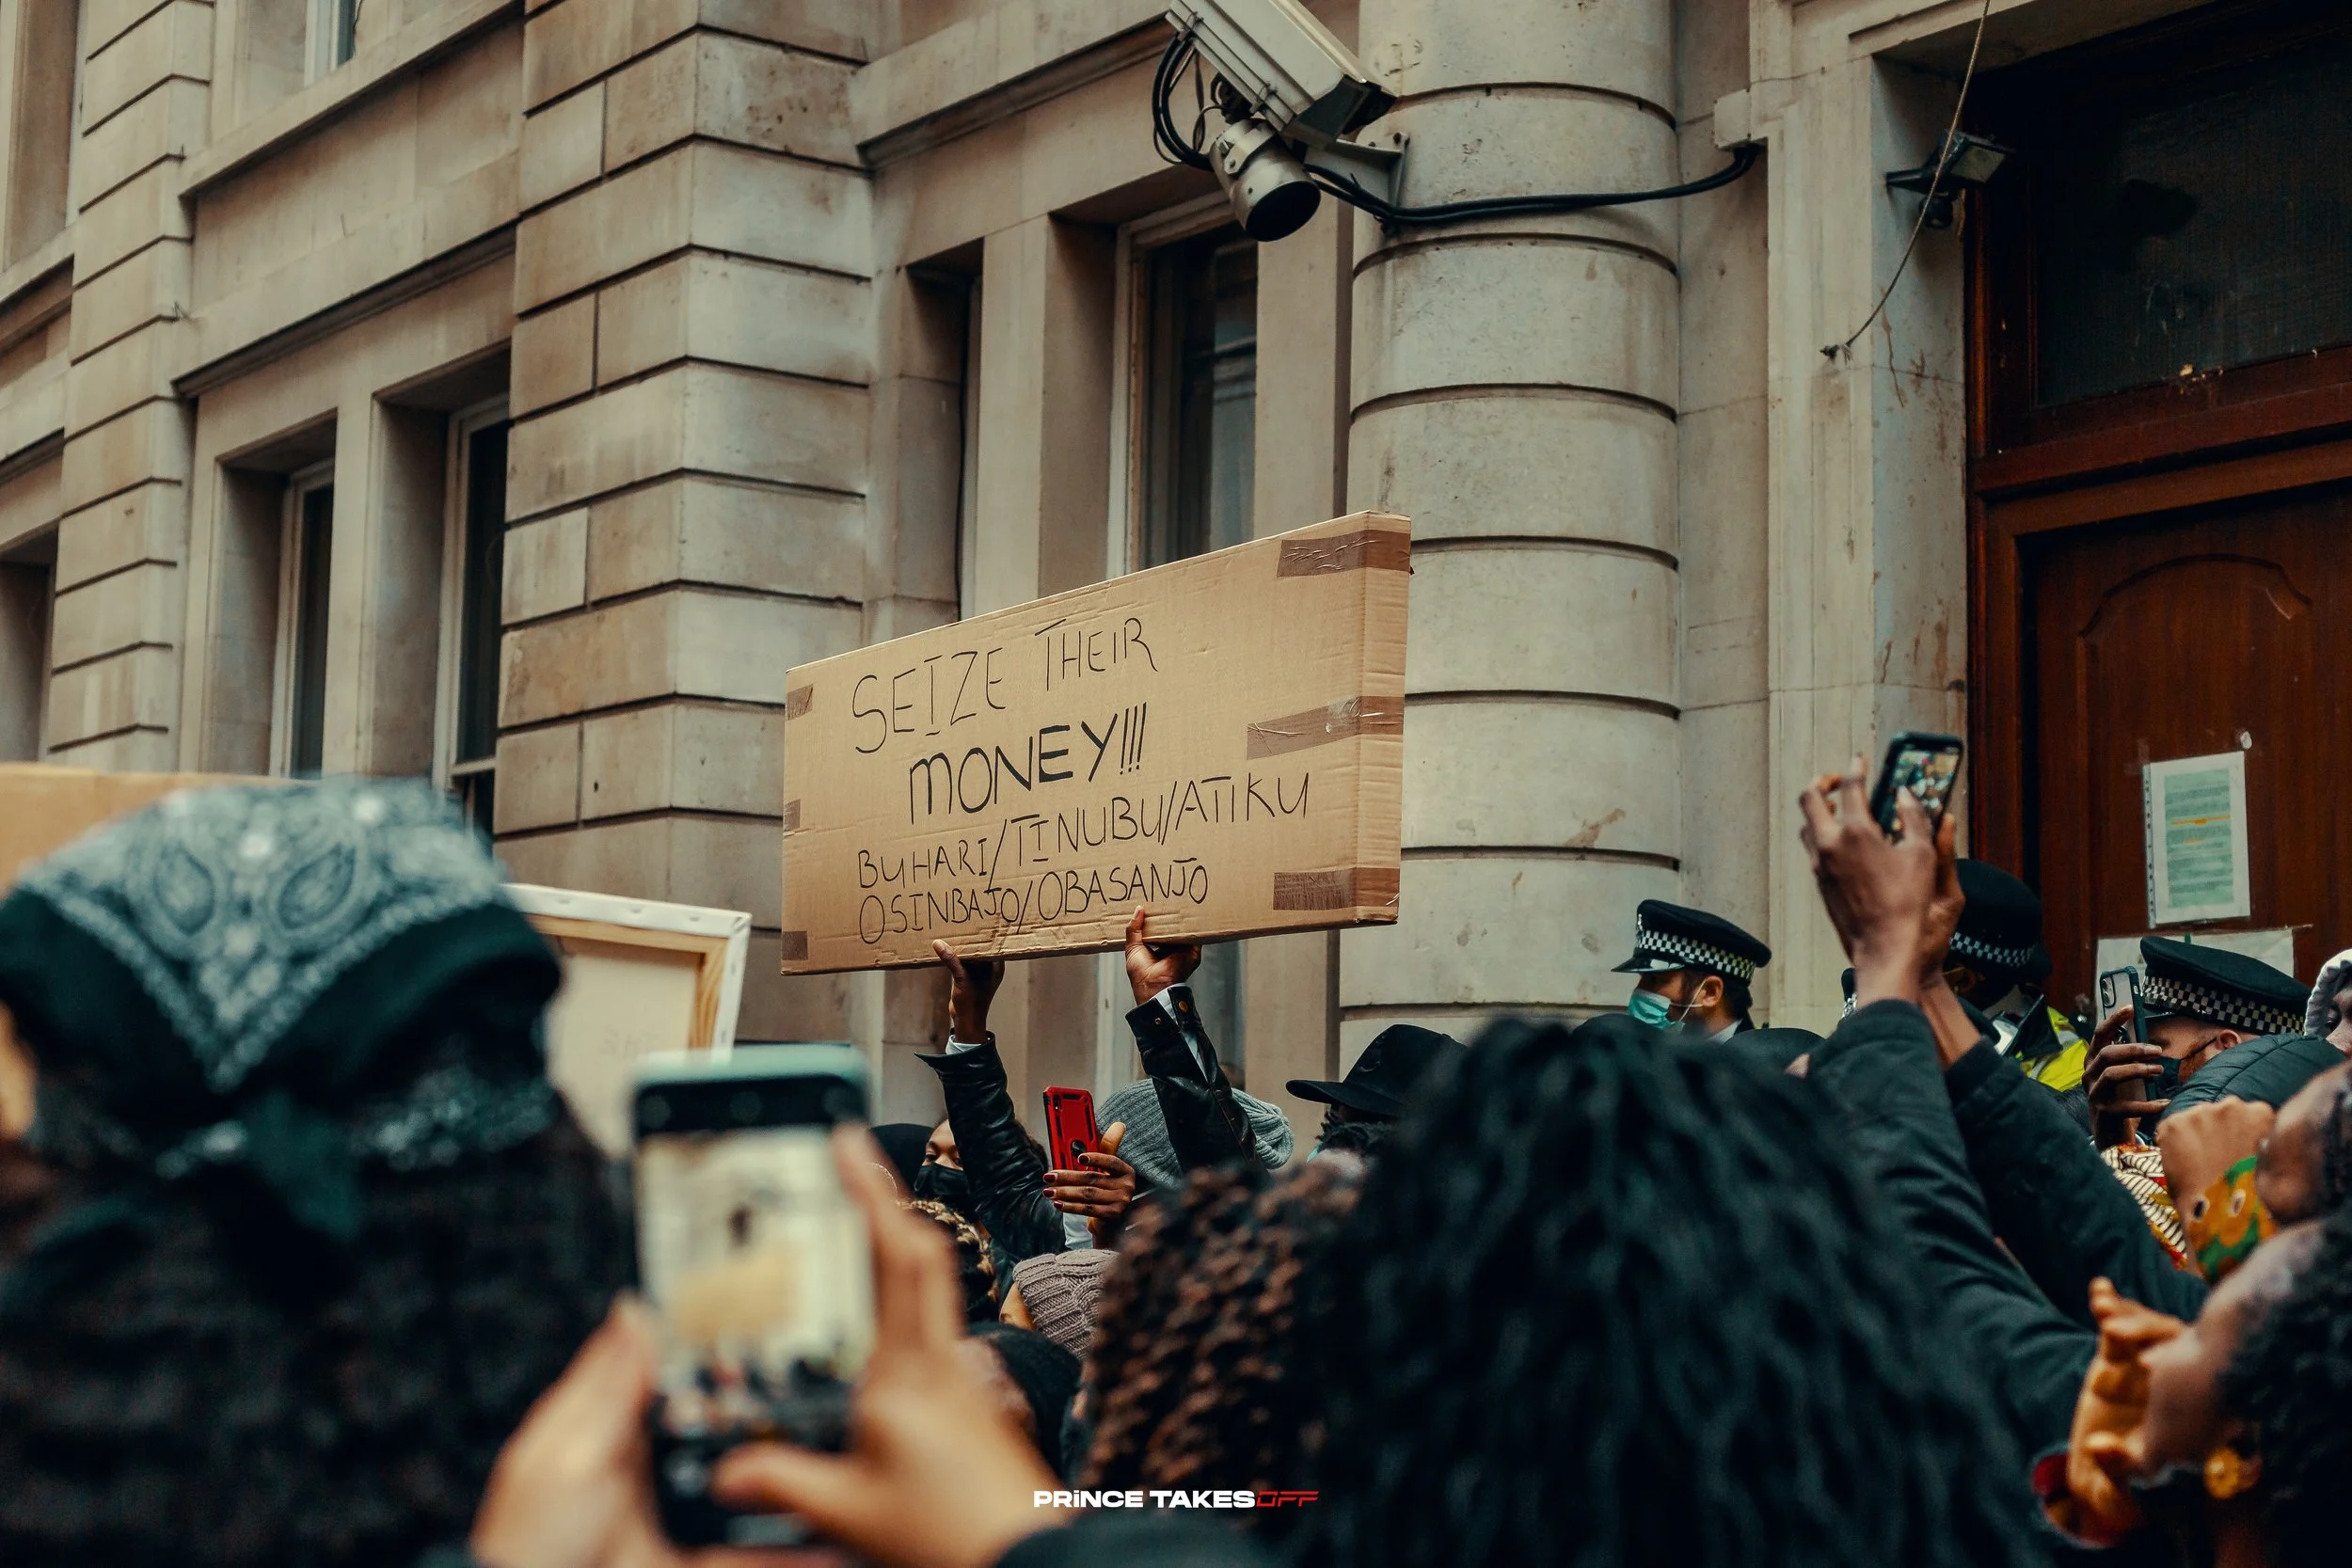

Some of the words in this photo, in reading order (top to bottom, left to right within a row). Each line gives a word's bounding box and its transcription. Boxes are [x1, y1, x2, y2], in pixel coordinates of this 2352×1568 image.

[852, 647, 1006, 753] SEIZE
[1035, 617, 1159, 691] THEIR
[909, 702, 1147, 825] MONEY!!!
